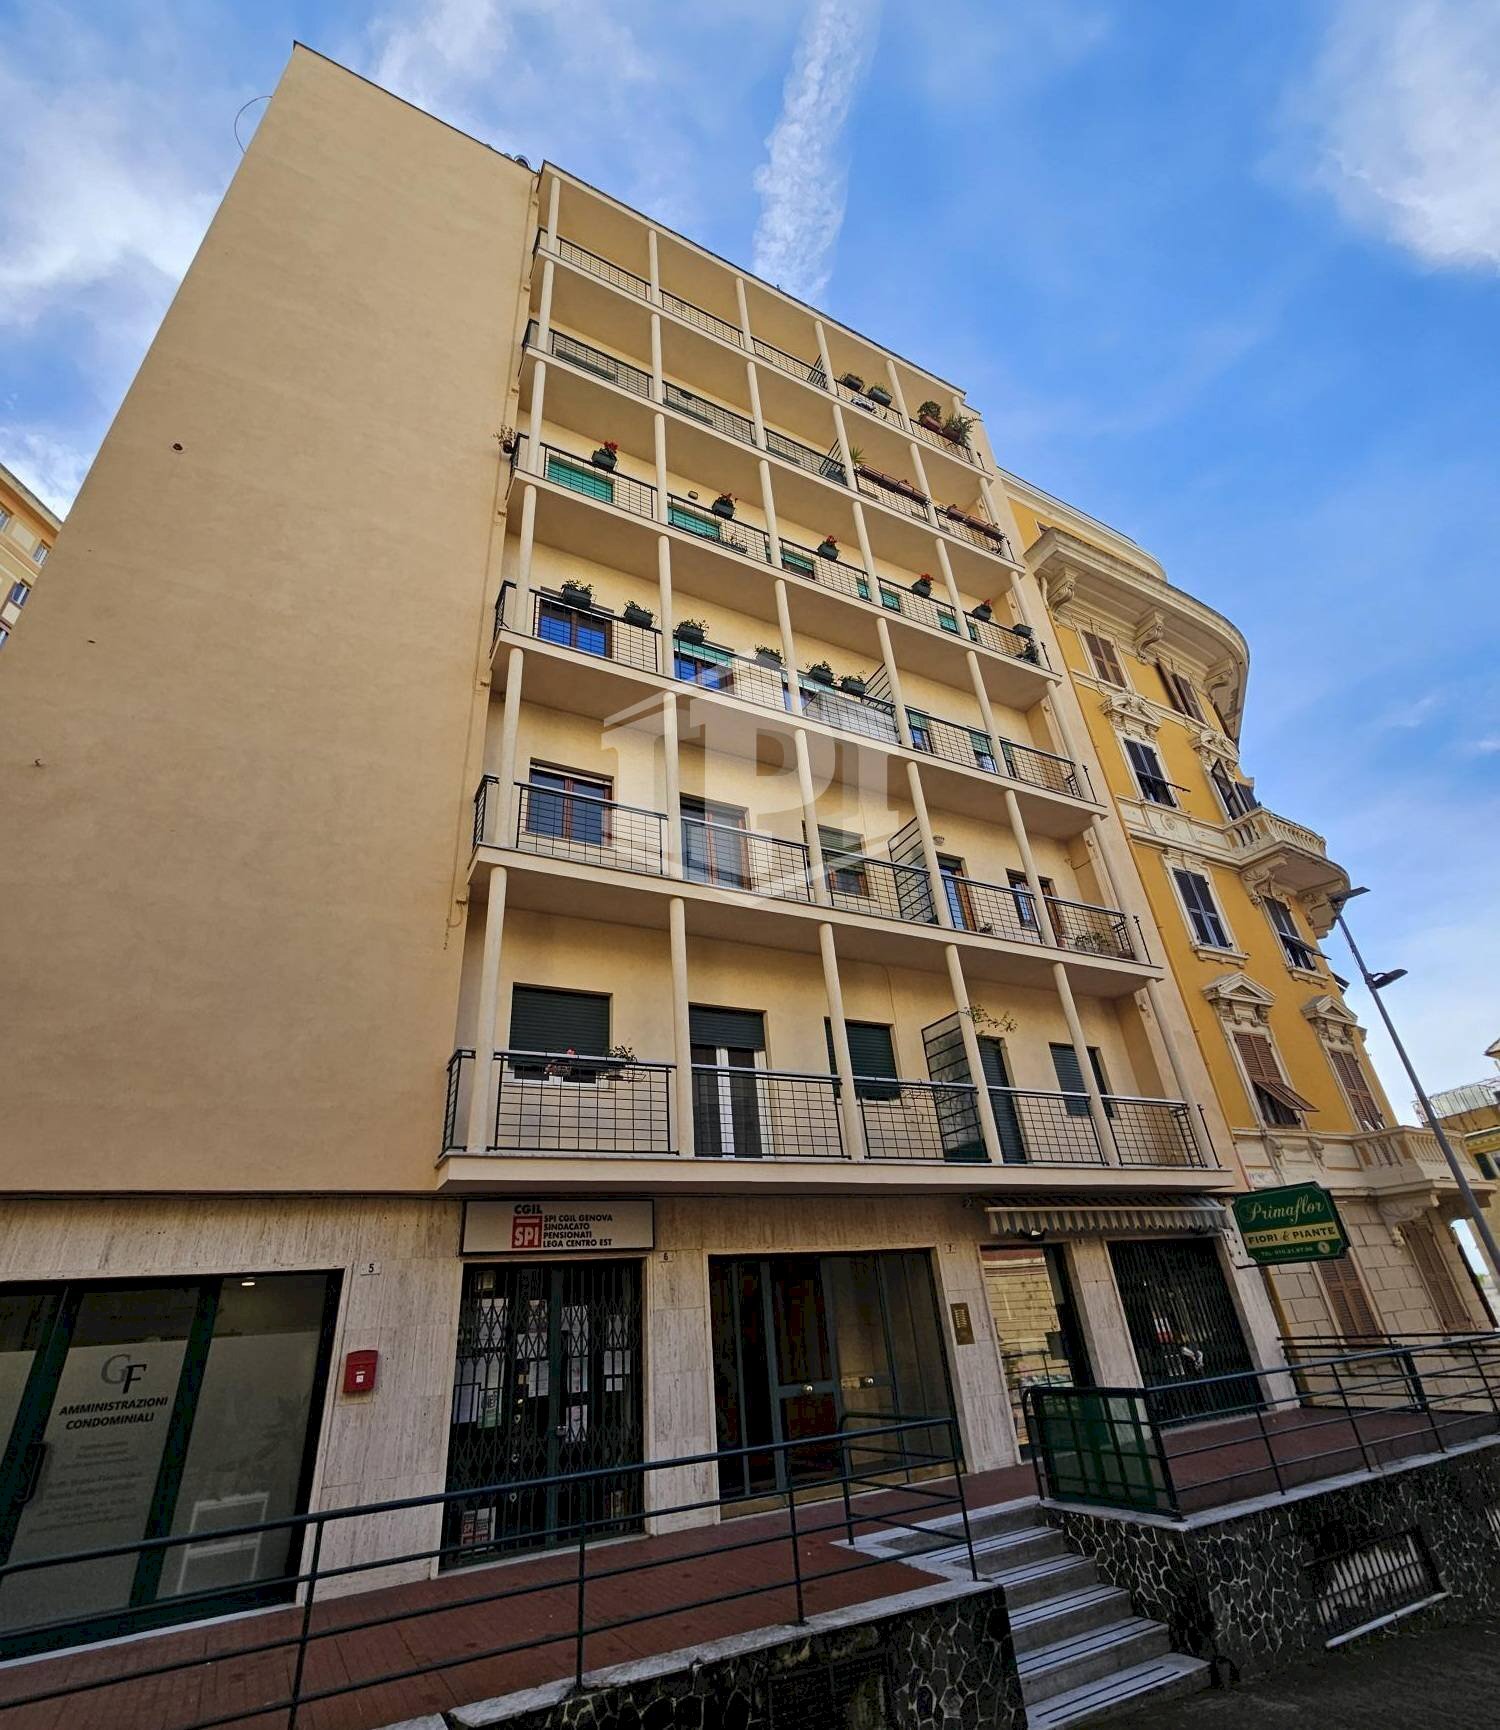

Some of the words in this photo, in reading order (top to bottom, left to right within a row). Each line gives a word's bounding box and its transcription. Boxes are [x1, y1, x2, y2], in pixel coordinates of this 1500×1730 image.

[514, 1204, 543, 1214] CGIL
[1243, 1193, 1325, 1224] Primaflor
[544, 1215, 557, 1223] SPI
[559, 1215, 577, 1223] CGIL
[579, 1214, 613, 1222] GENOVA
[543, 1223, 590, 1231] SINDACATO
[514, 1227, 540, 1246] SPI
[543, 1231, 593, 1239] PENSIONATI
[1248, 1233, 1279, 1245] FIORI
[1292, 1226, 1336, 1240] PIANTE
[543, 1240, 563, 1248] LEGA
[566, 1239, 597, 1247] CENTRO
[599, 1238, 612, 1246] EST
[663, 1252, 669, 1261] 6
[368, 1263, 375, 1273] 5
[101, 1353, 147, 1394] GF
[59, 1397, 169, 1416] AMMINISTRAZIONI
[66, 1412, 155, 1430] CONDOMINIALI
